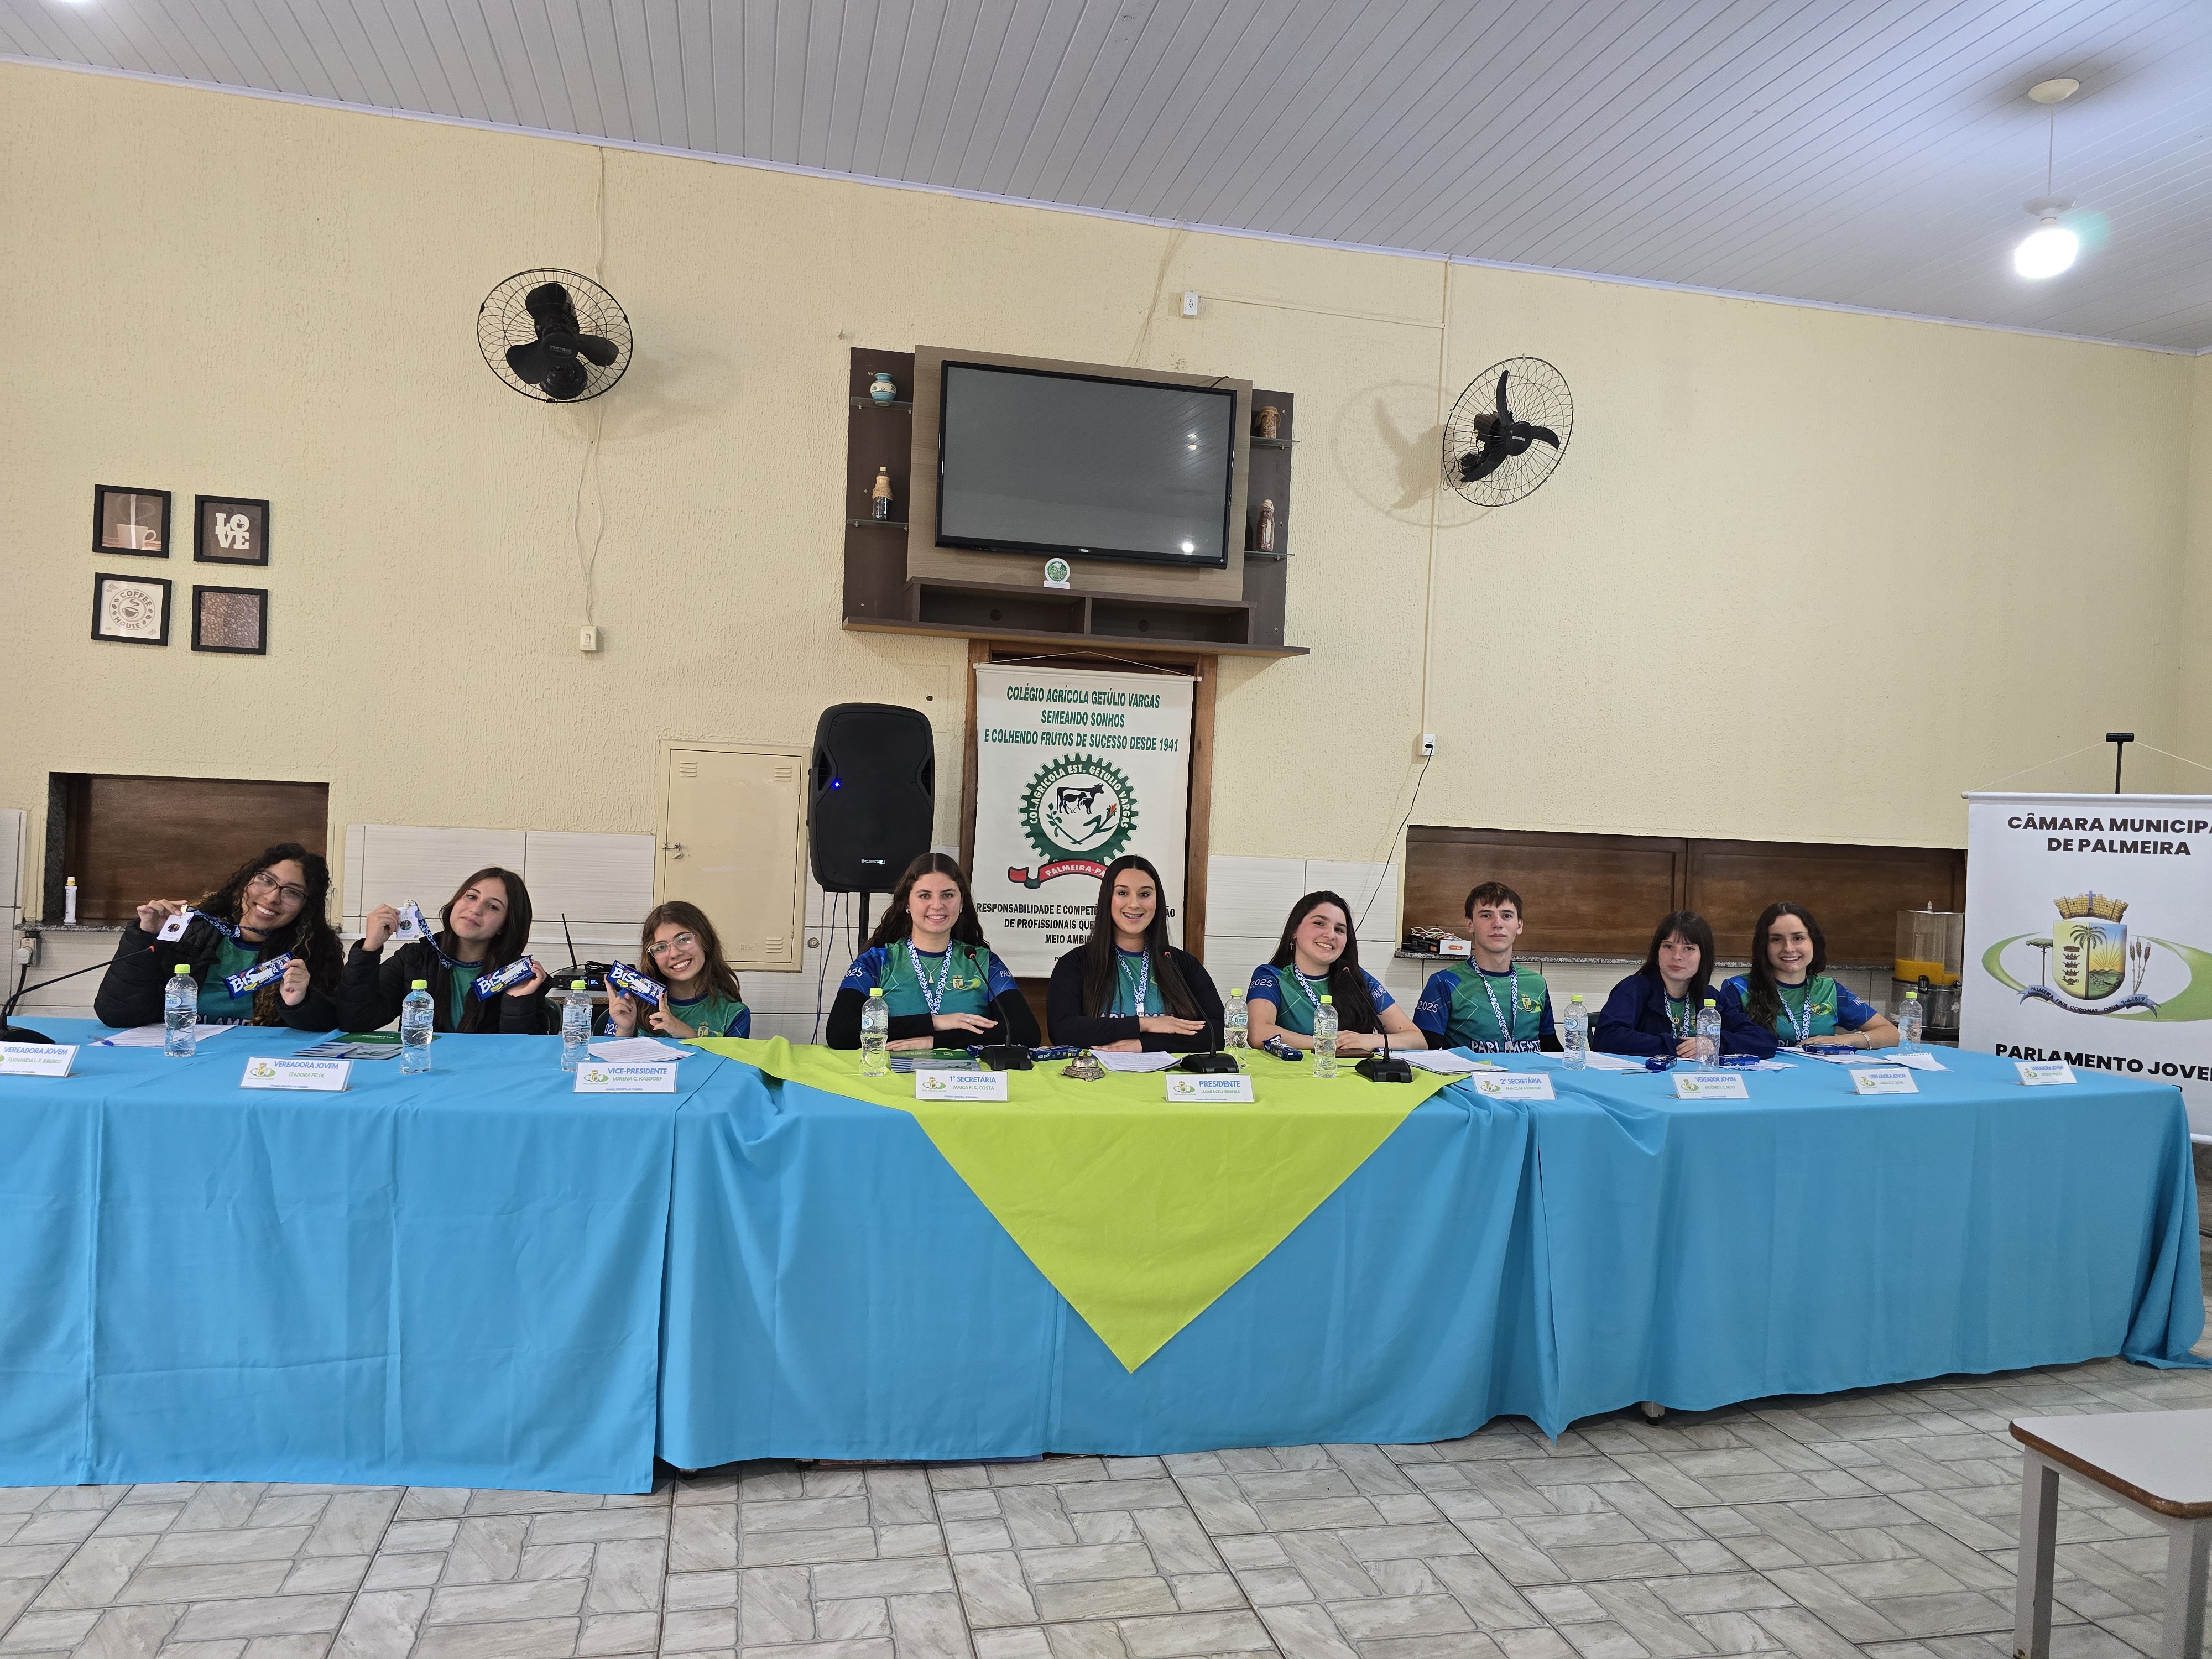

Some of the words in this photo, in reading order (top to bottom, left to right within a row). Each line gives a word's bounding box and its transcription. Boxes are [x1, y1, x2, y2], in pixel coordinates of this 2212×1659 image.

[119, 590, 152, 607] COFFEE
[114, 617, 141, 629] HOUSE
[1007, 684, 1044, 702] COLÉGIO
[1046, 685, 1089, 704] AGRÍCOLA
[1091, 688, 1126, 706] GETÚLIO
[1128, 693, 1160, 708] VARGAS
[1041, 709, 1088, 726] SEMEANDO
[1090, 712, 1125, 728] SONHOS
[984, 729, 989, 742] E
[992, 729, 1038, 745] COLHENDO
[1040, 731, 1073, 747] FRUTOS
[1076, 733, 1087, 747] DE
[1089, 734, 1128, 749] SUCESSO
[1130, 736, 1157, 750] DESDE
[1159, 738, 1178, 752] 1941
[1067, 764, 1086, 774] EST.
[1089, 766, 1121, 791] GETULIO
[1119, 790, 1130, 828] VARGAS
[2007, 812, 2105, 831] CÂMARA
[2047, 838, 2073, 852] DE
[2078, 839, 2191, 855] PALMEIRA
[976, 903, 1054, 914] RESPONSABILIDADE
[1056, 905, 1061, 914] E
[1063, 904, 1098, 915] COMPETÊ
[1004, 919, 1015, 928] DE
[1016, 919, 1077, 930] PROFISSIONAIS
[1078, 920, 1095, 930] QUE
[1045, 935, 1065, 943] MEIO
[1067, 935, 1092, 944] AMBI
[845, 967, 863, 977] 025
[1250, 979, 1273, 989] 2025
[1417, 1001, 1439, 1013] 2025
[2030, 987, 2054, 1000] PALMEIRA
[2055, 998, 2068, 1008] FINIS
[2070, 1005, 2098, 1014] CORONAT
[1996, 1044, 2143, 1073] PARLAMENTO
[2147, 1061, 2212, 1081] JOVE
